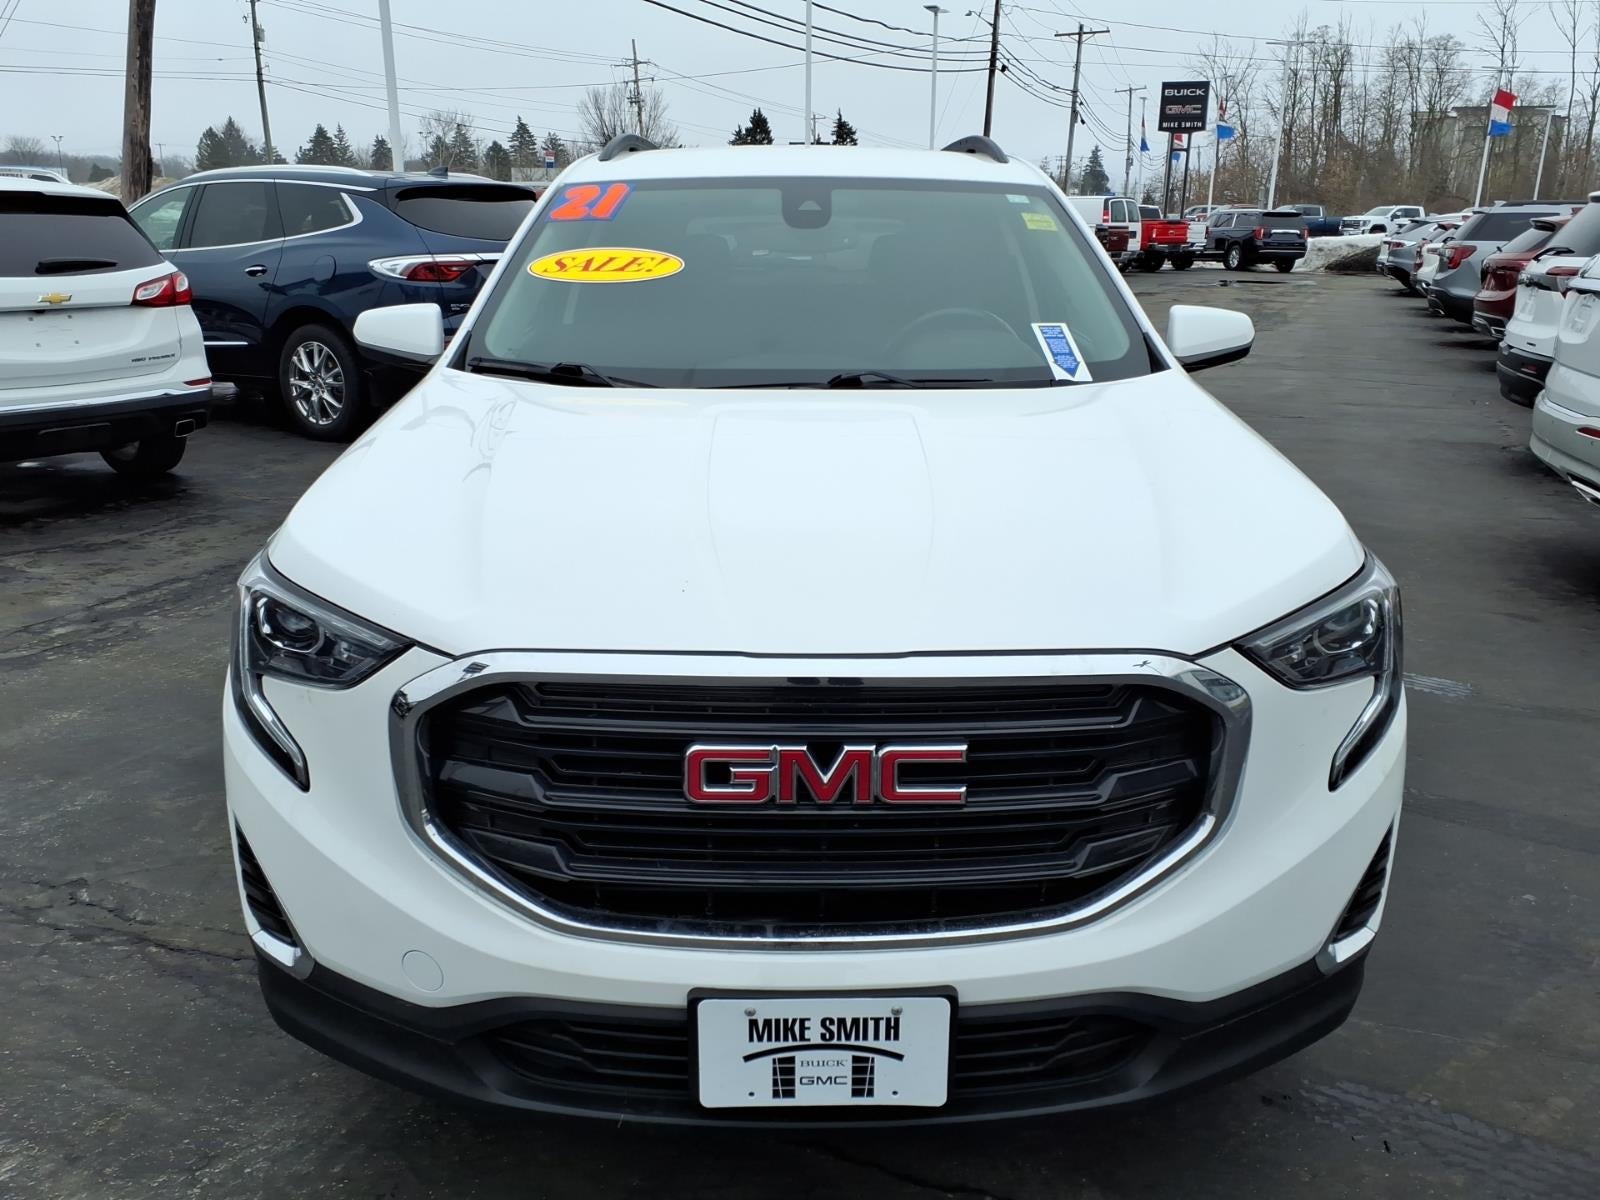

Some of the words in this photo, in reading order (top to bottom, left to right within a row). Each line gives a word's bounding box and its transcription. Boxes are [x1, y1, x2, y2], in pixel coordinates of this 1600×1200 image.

[1165, 88, 1205, 96] BUICK
[1165, 104, 1202, 114] GMC
[550, 182, 630, 221] 21
[542, 255, 671, 273] SALE!
[683, 743, 968, 805] GMC
[748, 1017, 811, 1043] MIKE
[820, 1016, 900, 1042] SMITH
[800, 1059, 847, 1068] BUICK
[799, 1075, 848, 1086] GMC
